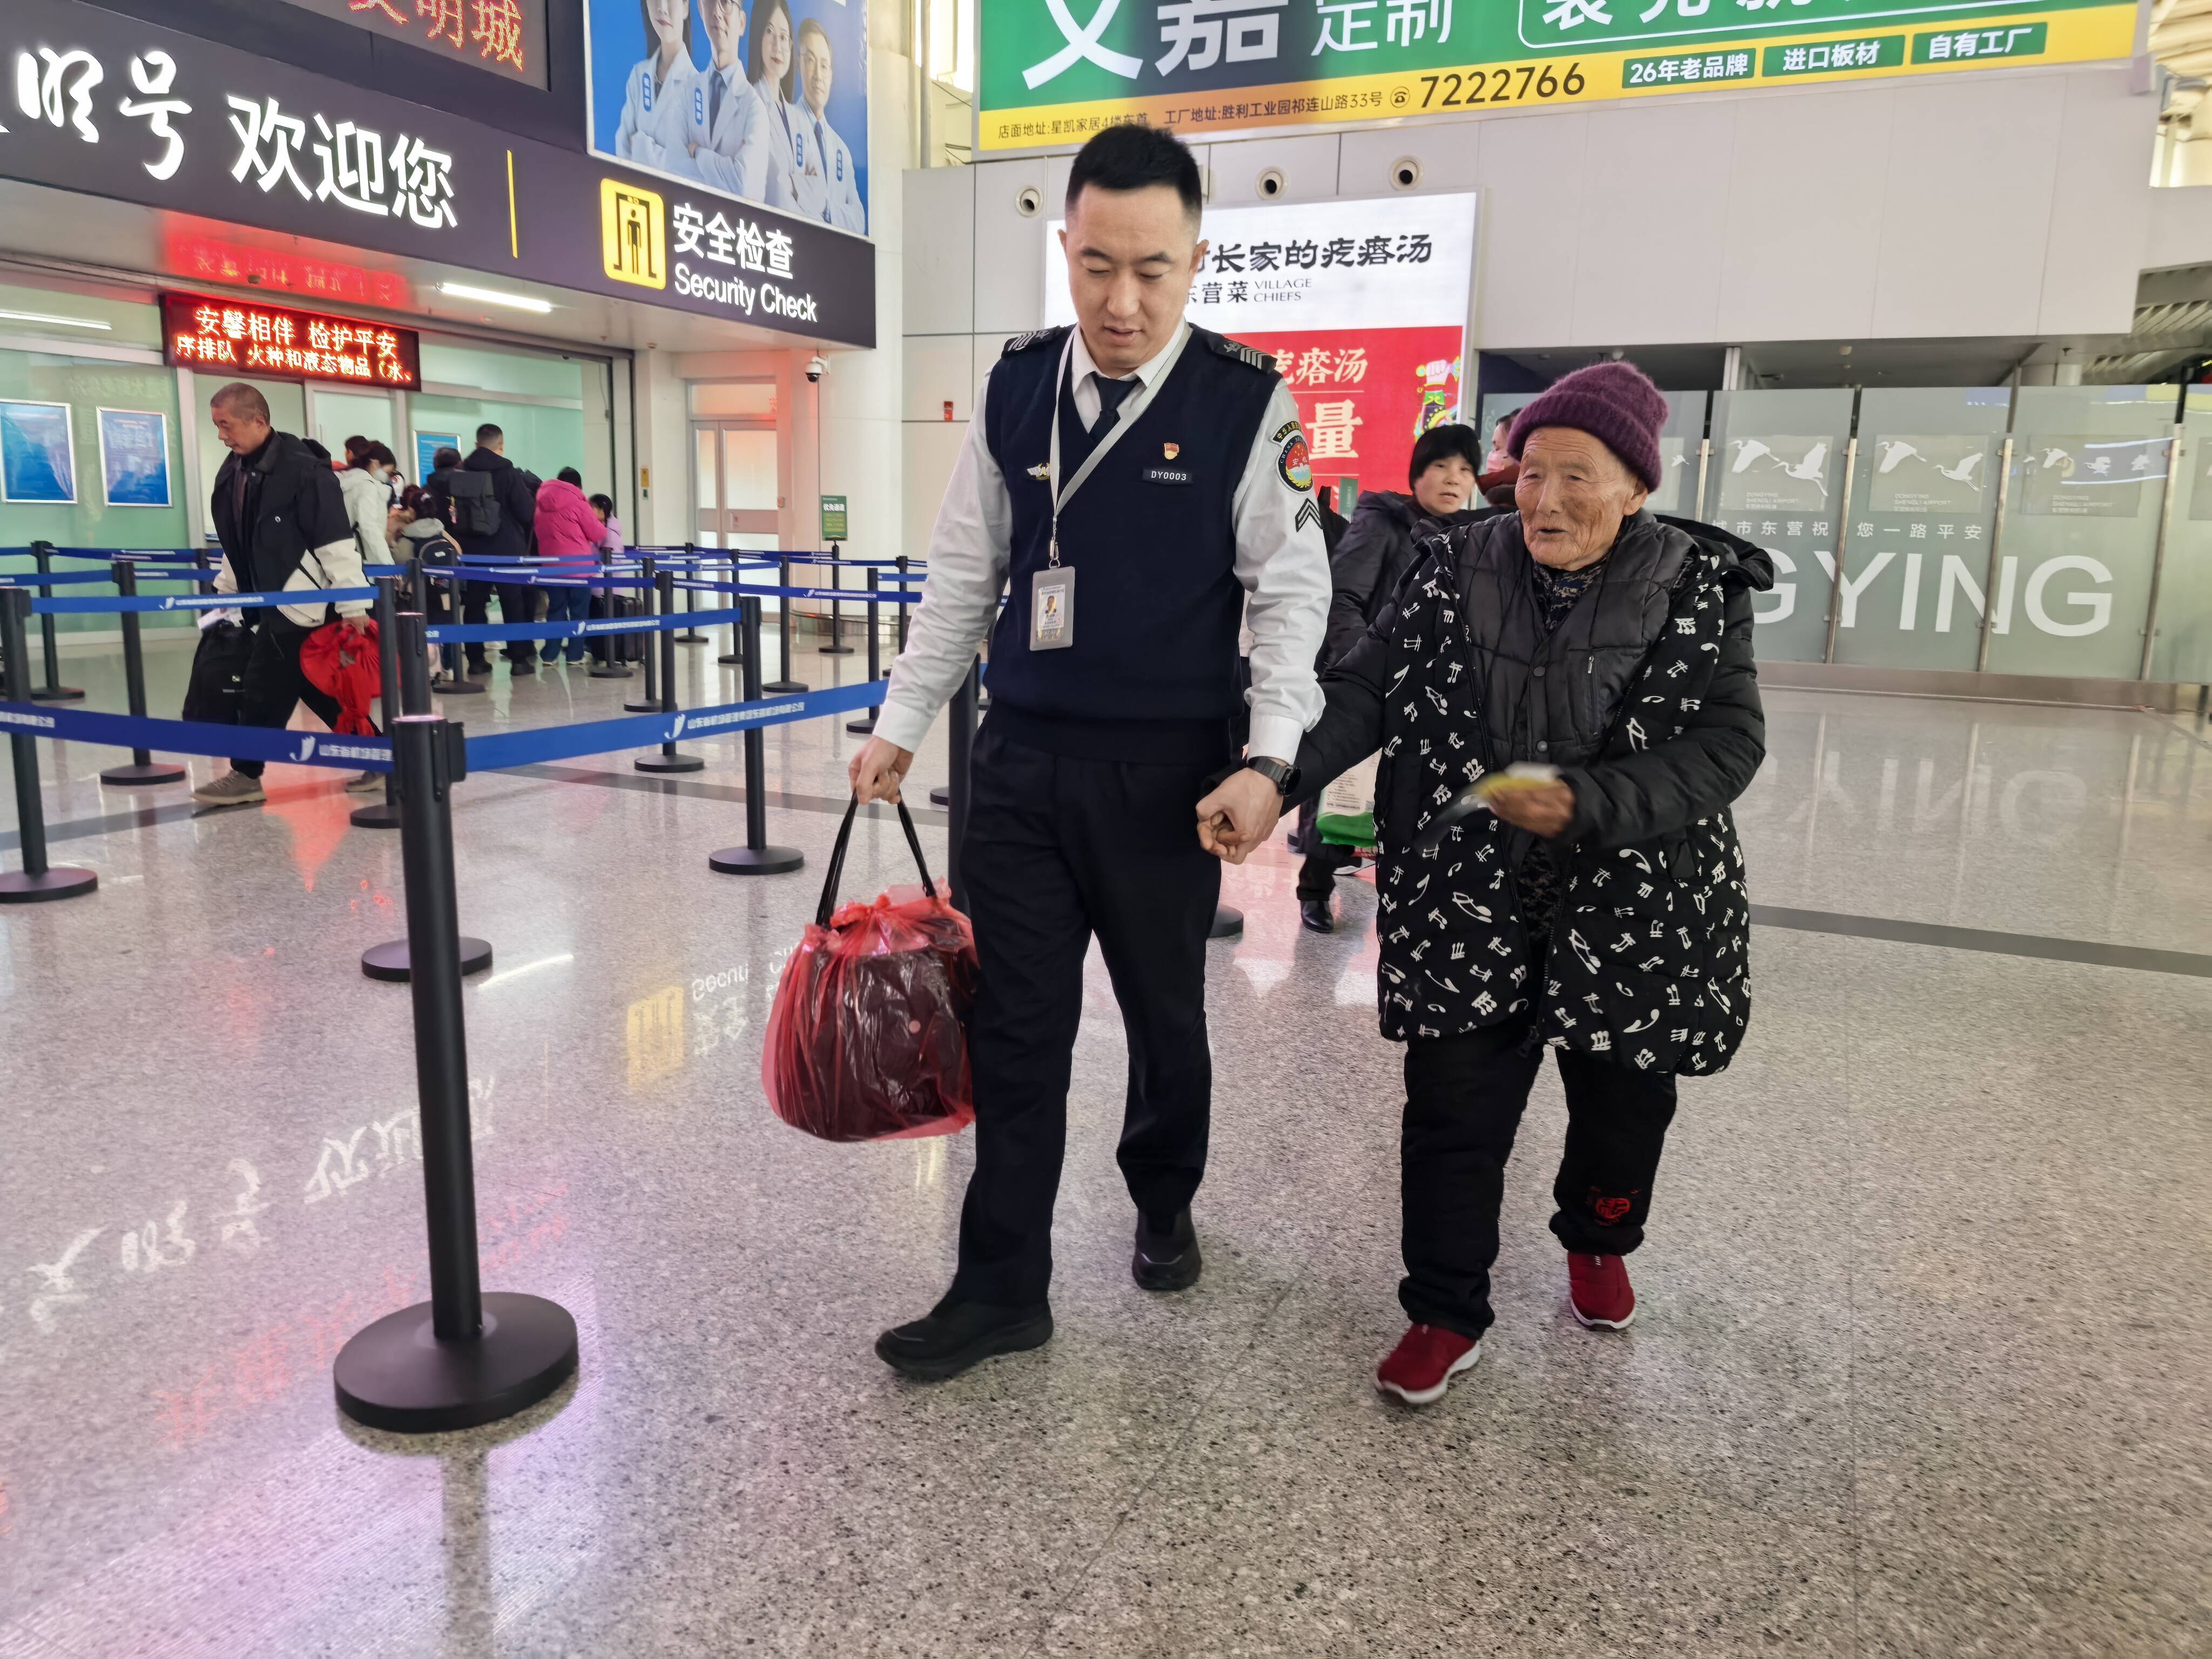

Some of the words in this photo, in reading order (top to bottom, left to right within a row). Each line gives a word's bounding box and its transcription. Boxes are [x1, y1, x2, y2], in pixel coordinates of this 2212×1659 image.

[1783, 42, 1881, 72] 进口板材
[1929, 27, 2033, 59] 自有工厂
[1629, 53, 1749, 83] 26年老品牌
[1420, 62, 1587, 108] 7222766
[0, 46, 193, 180] 明号
[226, 93, 459, 230] 欢迎您
[672, 203, 794, 280] 安全检查
[674, 263, 756, 316] Security
[760, 283, 818, 322] Check
[1253, 292, 1302, 303] CHIEFS
[1255, 278, 1312, 291] VILLAGE
[1295, 399, 1364, 460] 量
[1151, 470, 1187, 481] DY0003
